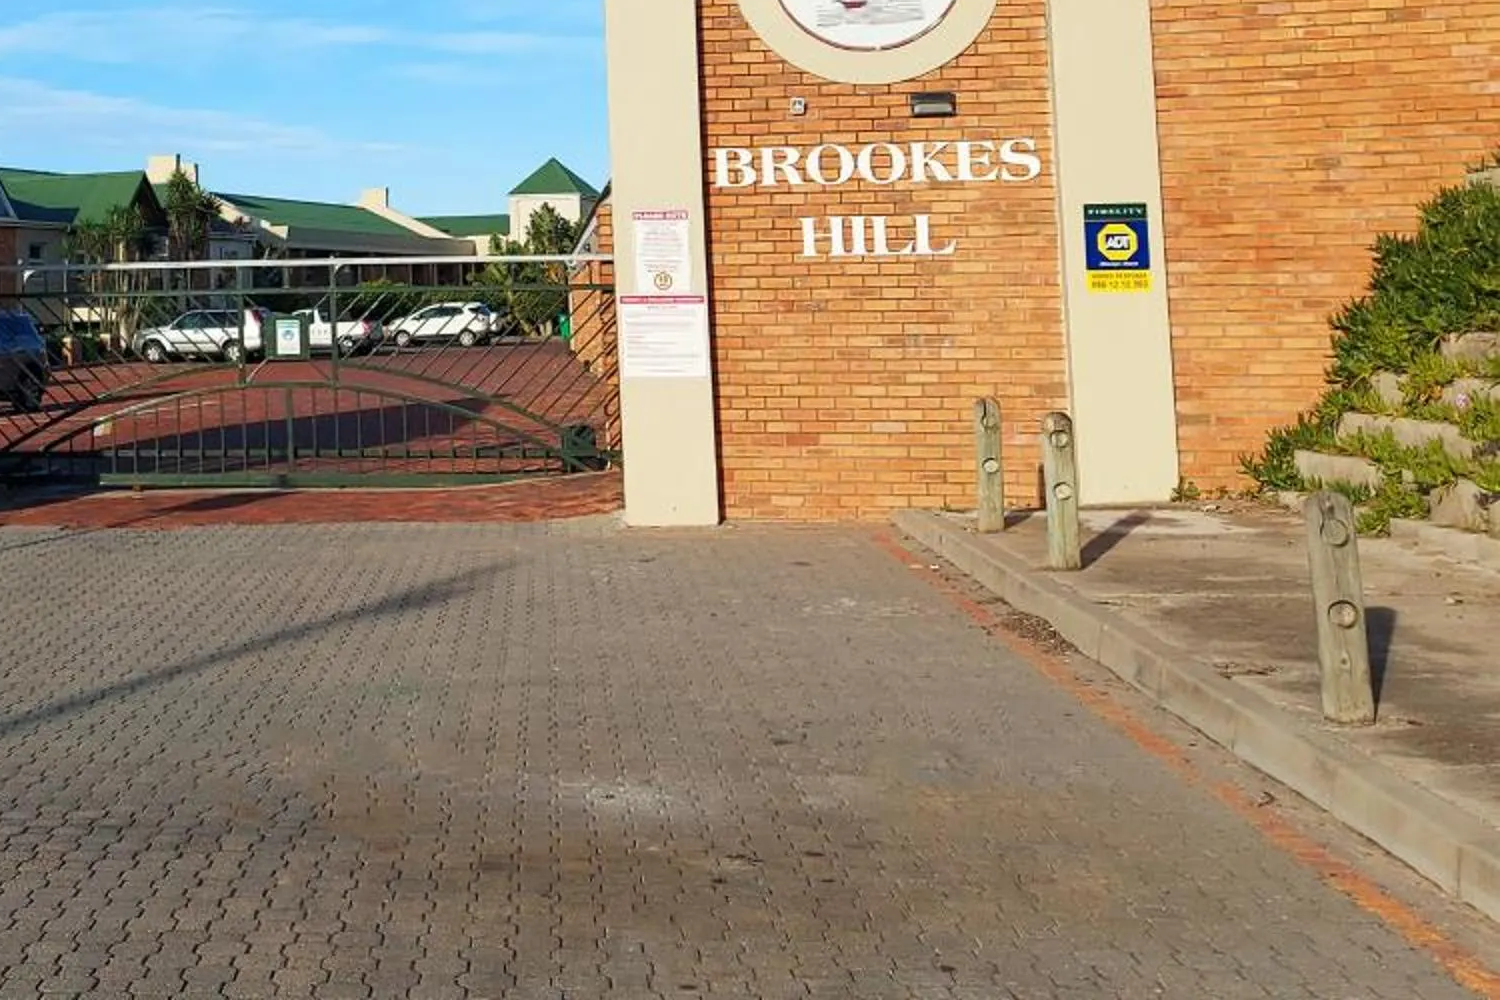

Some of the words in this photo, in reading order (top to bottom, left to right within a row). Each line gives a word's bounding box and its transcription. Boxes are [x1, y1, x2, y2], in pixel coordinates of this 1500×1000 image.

[713, 137, 1042, 188] BROOKES
[1088, 207, 1142, 215] FIDELITY
[799, 214, 958, 258] HILL
[1106, 235, 1130, 249] ADT
